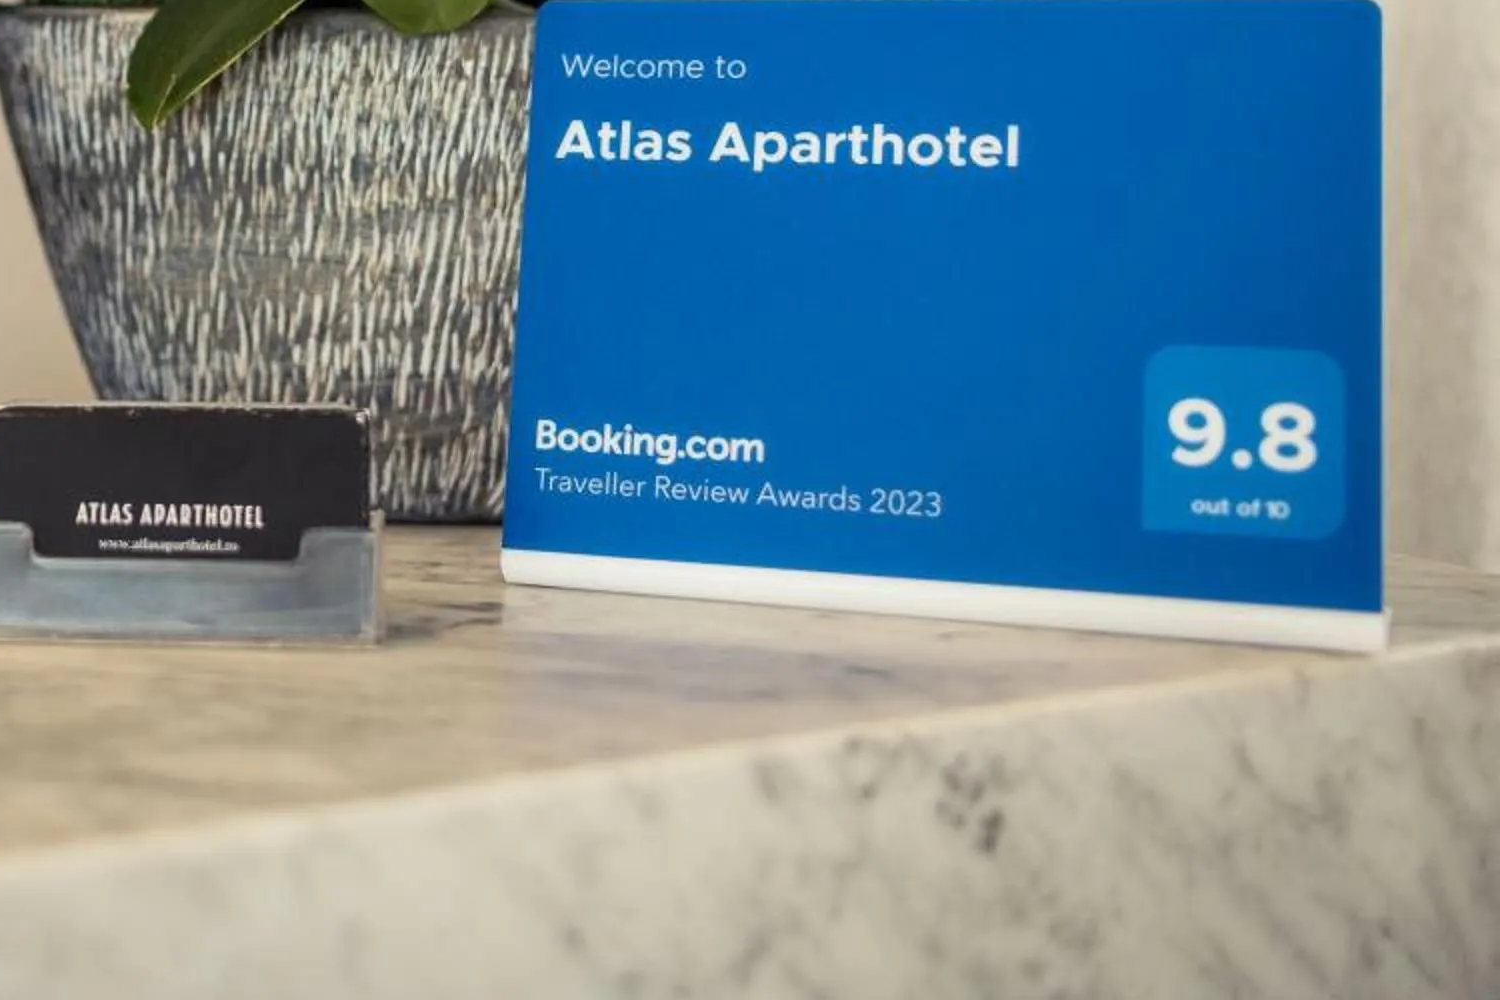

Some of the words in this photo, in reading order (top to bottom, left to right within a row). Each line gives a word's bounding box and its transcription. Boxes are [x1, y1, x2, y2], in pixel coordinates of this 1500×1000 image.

[561, 53, 704, 80] Welcome
[716, 55, 747, 80] to
[556, 119, 693, 162] Atlas
[708, 121, 1021, 173] Aparthotel
[535, 419, 766, 465] Booking.com
[1167, 397, 1319, 473] 9.8
[75, 502, 134, 526] ATLAS
[140, 504, 266, 529] APARTHOTEL
[535, 467, 647, 498] Traveller
[655, 477, 750, 505] Review
[756, 482, 861, 512] Awards
[869, 488, 943, 518] 2023
[1191, 499, 1230, 516] out
[1236, 499, 1262, 518] of
[1265, 501, 1291, 520] 10
